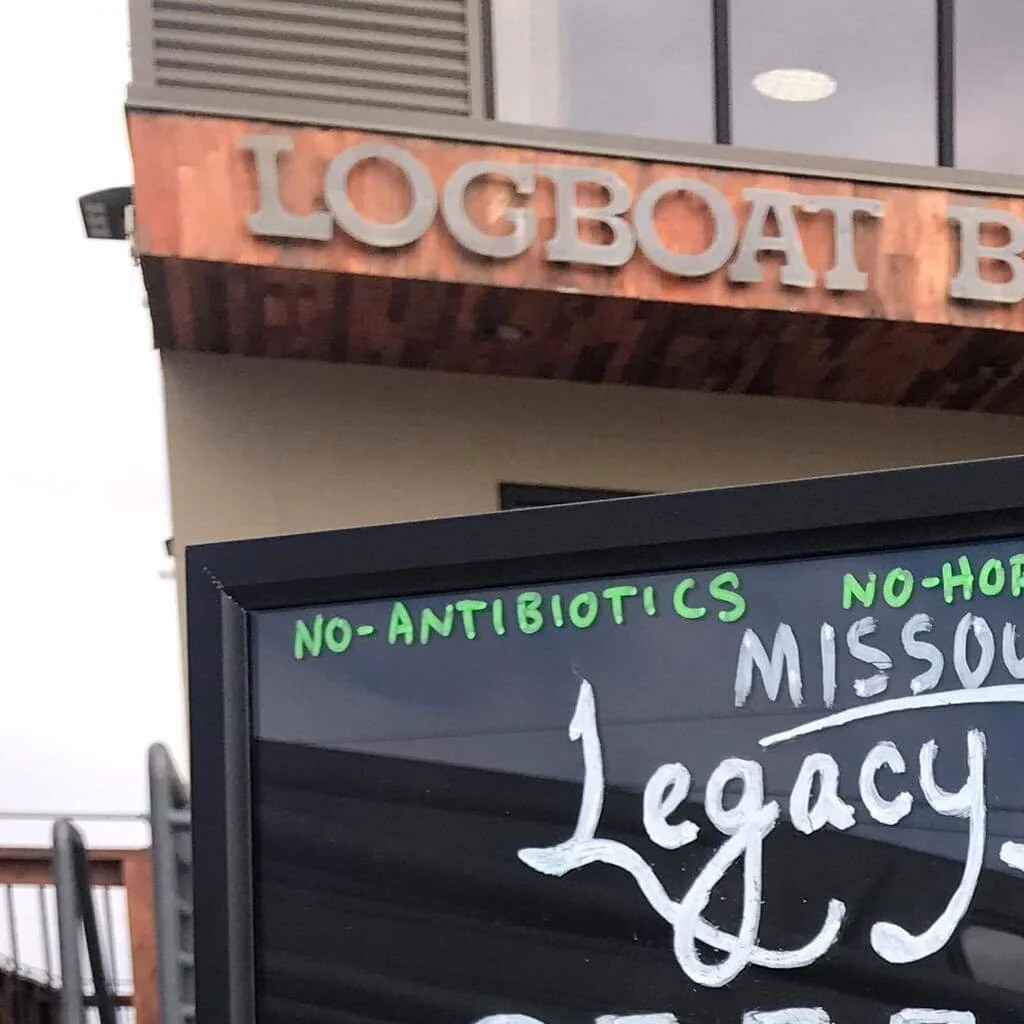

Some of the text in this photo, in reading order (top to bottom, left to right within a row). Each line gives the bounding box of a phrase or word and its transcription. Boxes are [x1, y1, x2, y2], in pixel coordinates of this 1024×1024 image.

[241, 132, 884, 293] LOGBOAT
[294, 571, 747, 659] NO-ANTIBIOTICS
[517, 677, 988, 988] Legacy
